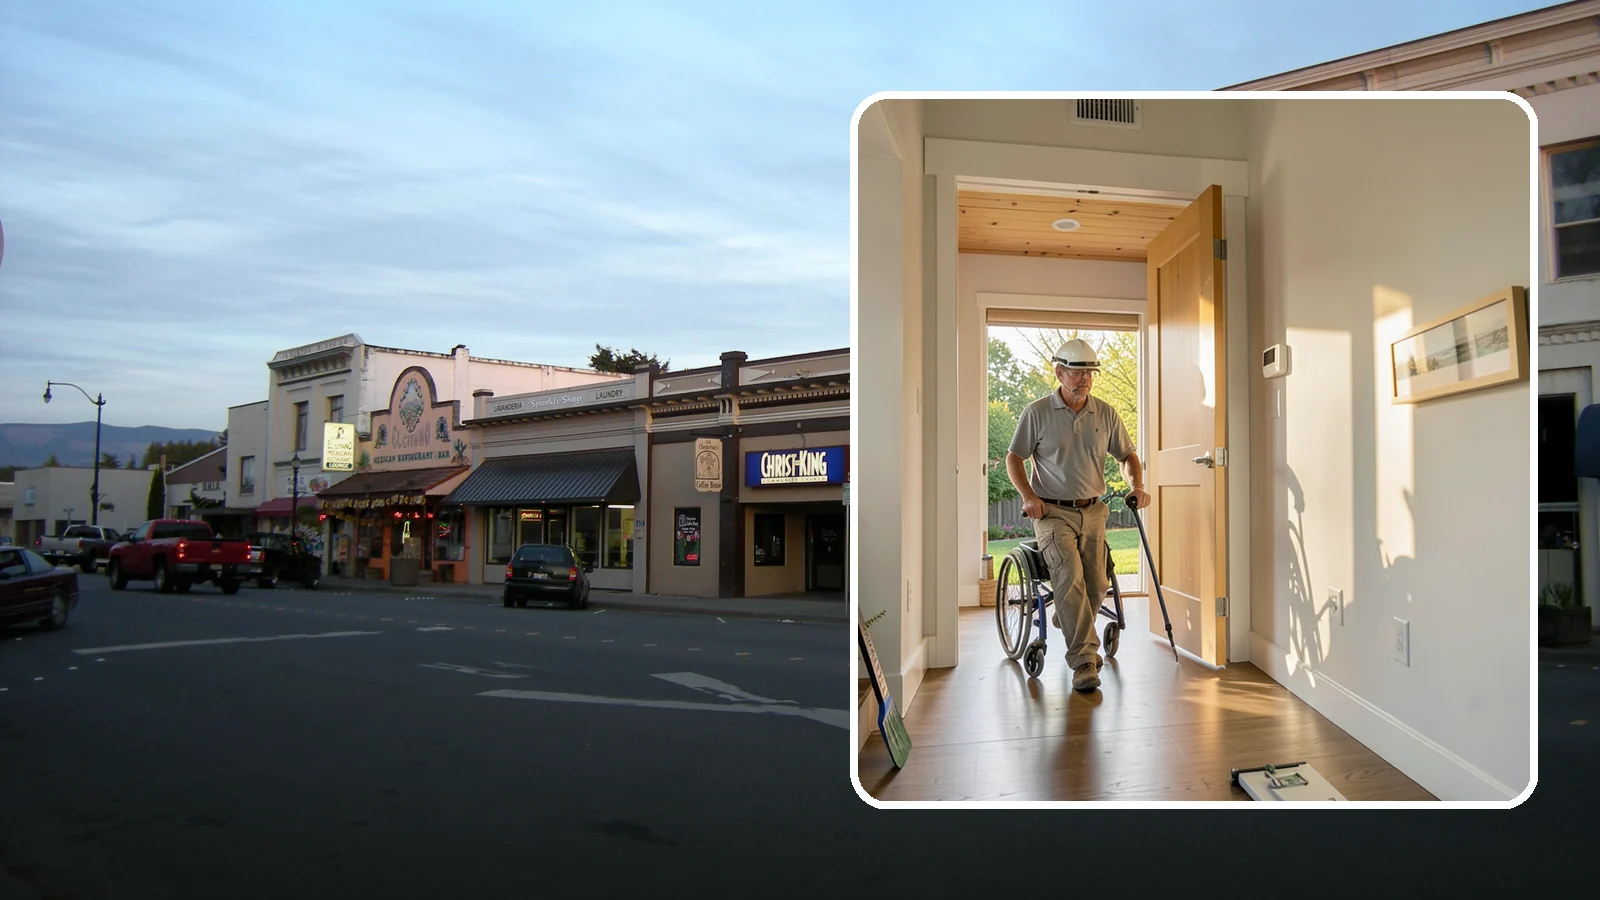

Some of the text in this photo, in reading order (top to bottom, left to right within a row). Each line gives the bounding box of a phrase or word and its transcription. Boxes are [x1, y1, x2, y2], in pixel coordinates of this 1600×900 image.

[595, 389, 623, 400] LAUNDRY
[530, 394, 582, 408] Sparkle Shop
[493, 402, 522, 413] LAVANDERIA
[373, 455, 396, 464] MEXICAN
[397, 451, 433, 462] RESTAURANT
[437, 450, 450, 459] BAR
[761, 450, 827, 478] CHRIST KING
[696, 480, 722, 489] Coffee House
